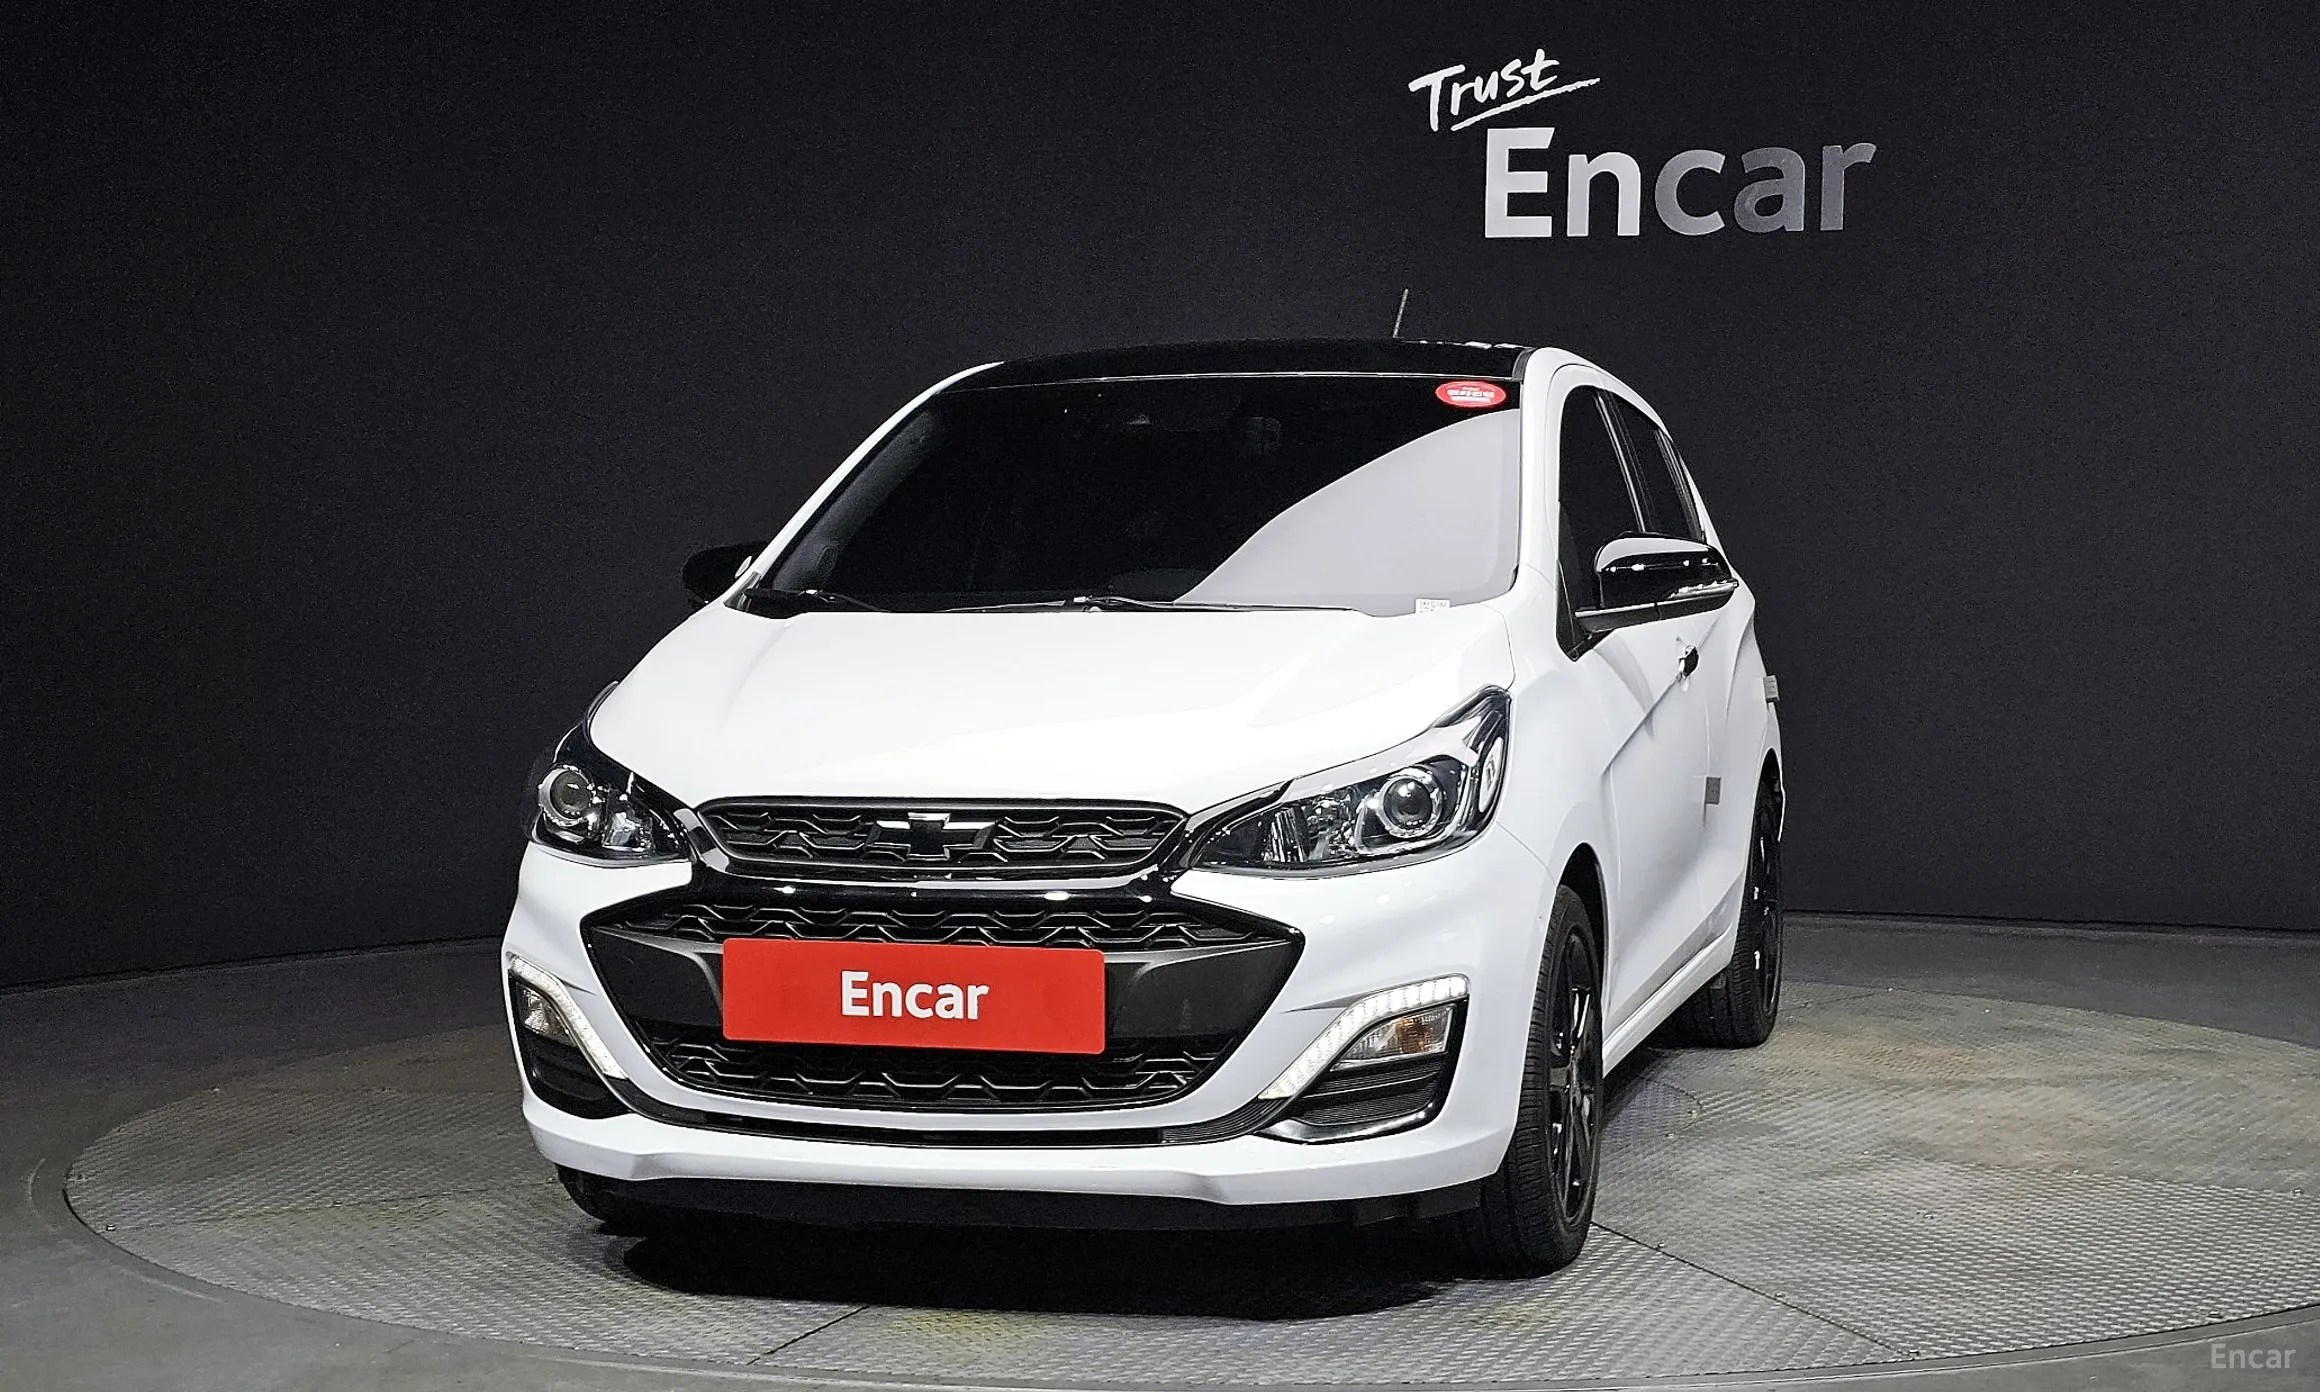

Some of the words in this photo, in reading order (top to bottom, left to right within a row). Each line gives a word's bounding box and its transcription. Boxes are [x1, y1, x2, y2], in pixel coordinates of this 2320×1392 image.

[1408, 48, 1561, 132] Trust
[1484, 127, 1877, 239] Encar
[841, 970, 989, 1020] Encar
